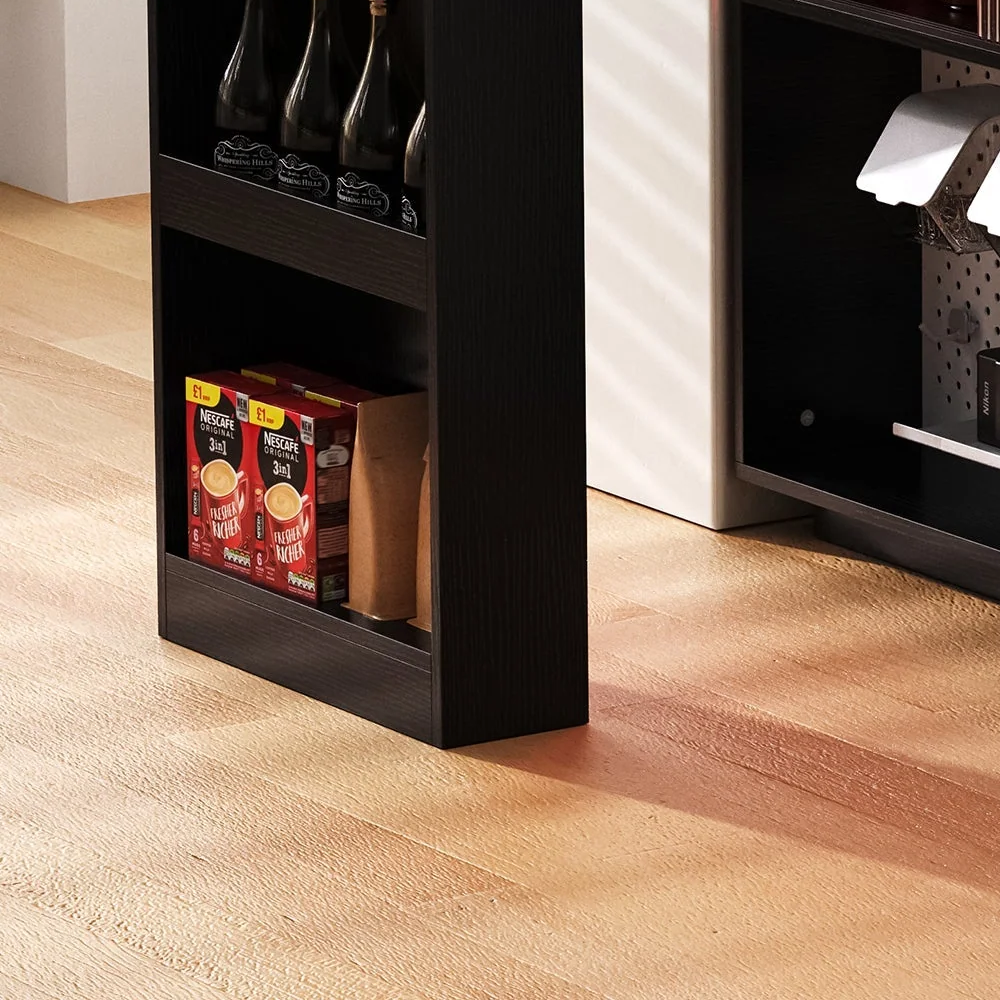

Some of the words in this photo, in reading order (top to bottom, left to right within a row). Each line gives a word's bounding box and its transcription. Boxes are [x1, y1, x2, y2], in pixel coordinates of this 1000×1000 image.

[193, 384, 202, 400] £1
[982, 380, 990, 416] Nikon
[200, 407, 235, 431] NESCAFÉ
[256, 407, 266, 422] £1
[200, 423, 235, 440] ORIGINAL
[209, 437, 227, 456] 3in1
[263, 430, 300, 454] NESCAFÉ
[263, 446, 299, 463] ORIGINAL
[272, 459, 291, 479] 3in1
[210, 501, 238, 521] FRESHER
[193, 529, 199, 542] 6
[212, 516, 241, 540] RICHER
[274, 524, 302, 545] FRESHER
[256, 552, 262, 566] 6
[276, 540, 305, 564] RICHER
